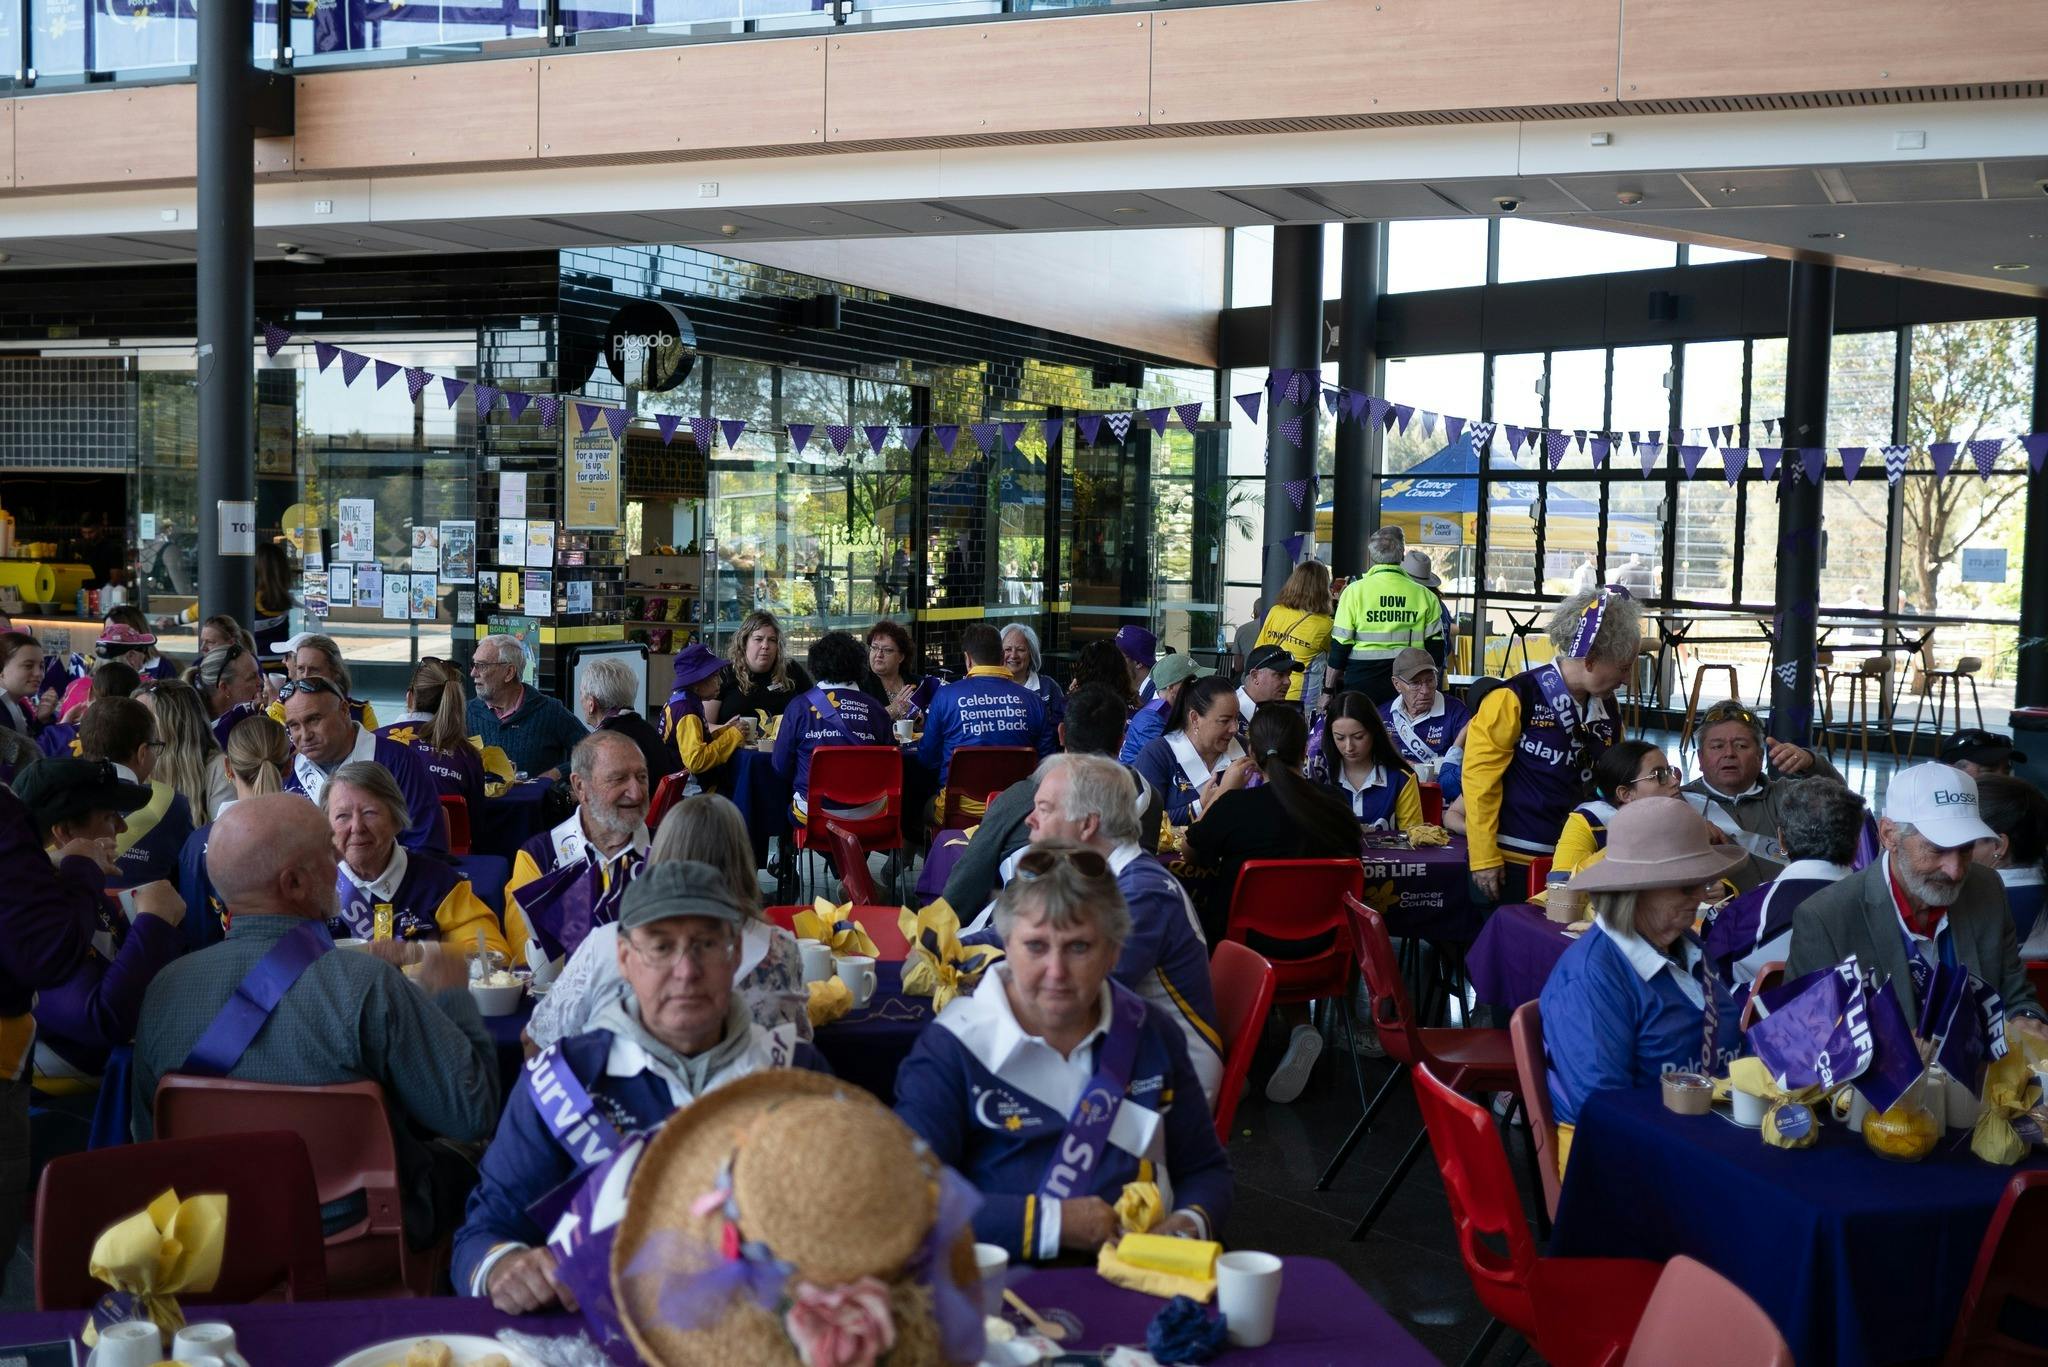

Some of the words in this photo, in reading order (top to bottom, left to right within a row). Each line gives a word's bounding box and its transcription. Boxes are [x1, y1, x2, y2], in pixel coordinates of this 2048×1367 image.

[613, 330, 673, 349] piccolo
[576, 450, 588, 460] for
[589, 452, 593, 460] a
[595, 451, 610, 462] year
[585, 460, 592, 470] is
[593, 462, 602, 471] up
[577, 471, 588, 481] for
[589, 470, 610, 483] grabs!
[1415, 480, 1457, 489] Cancer
[1404, 488, 1451, 498] Council
[231, 522, 256, 533] TOIL
[1434, 520, 1451, 530] Cancer
[1434, 529, 1451, 538] Council
[1380, 596, 1407, 608] UOW
[1366, 610, 1419, 623] SECURITY
[1571, 616, 1588, 658] Cance
[840, 698, 869, 708] Cancer
[957, 693, 1023, 709] Celebrate.
[840, 704, 869, 714] Council
[963, 721, 996, 736] Fight
[429, 764, 462, 781] org.au
[128, 847, 150, 856] ncer
[122, 852, 150, 863] ouncil
[1363, 864, 1387, 879] OR
[1391, 863, 1427, 877] LIFE
[1400, 891, 1445, 901] Cancer
[1400, 899, 1444, 908] Council
[1981, 993, 2009, 1061] LIFE
[526, 1044, 613, 1165] Surviv
